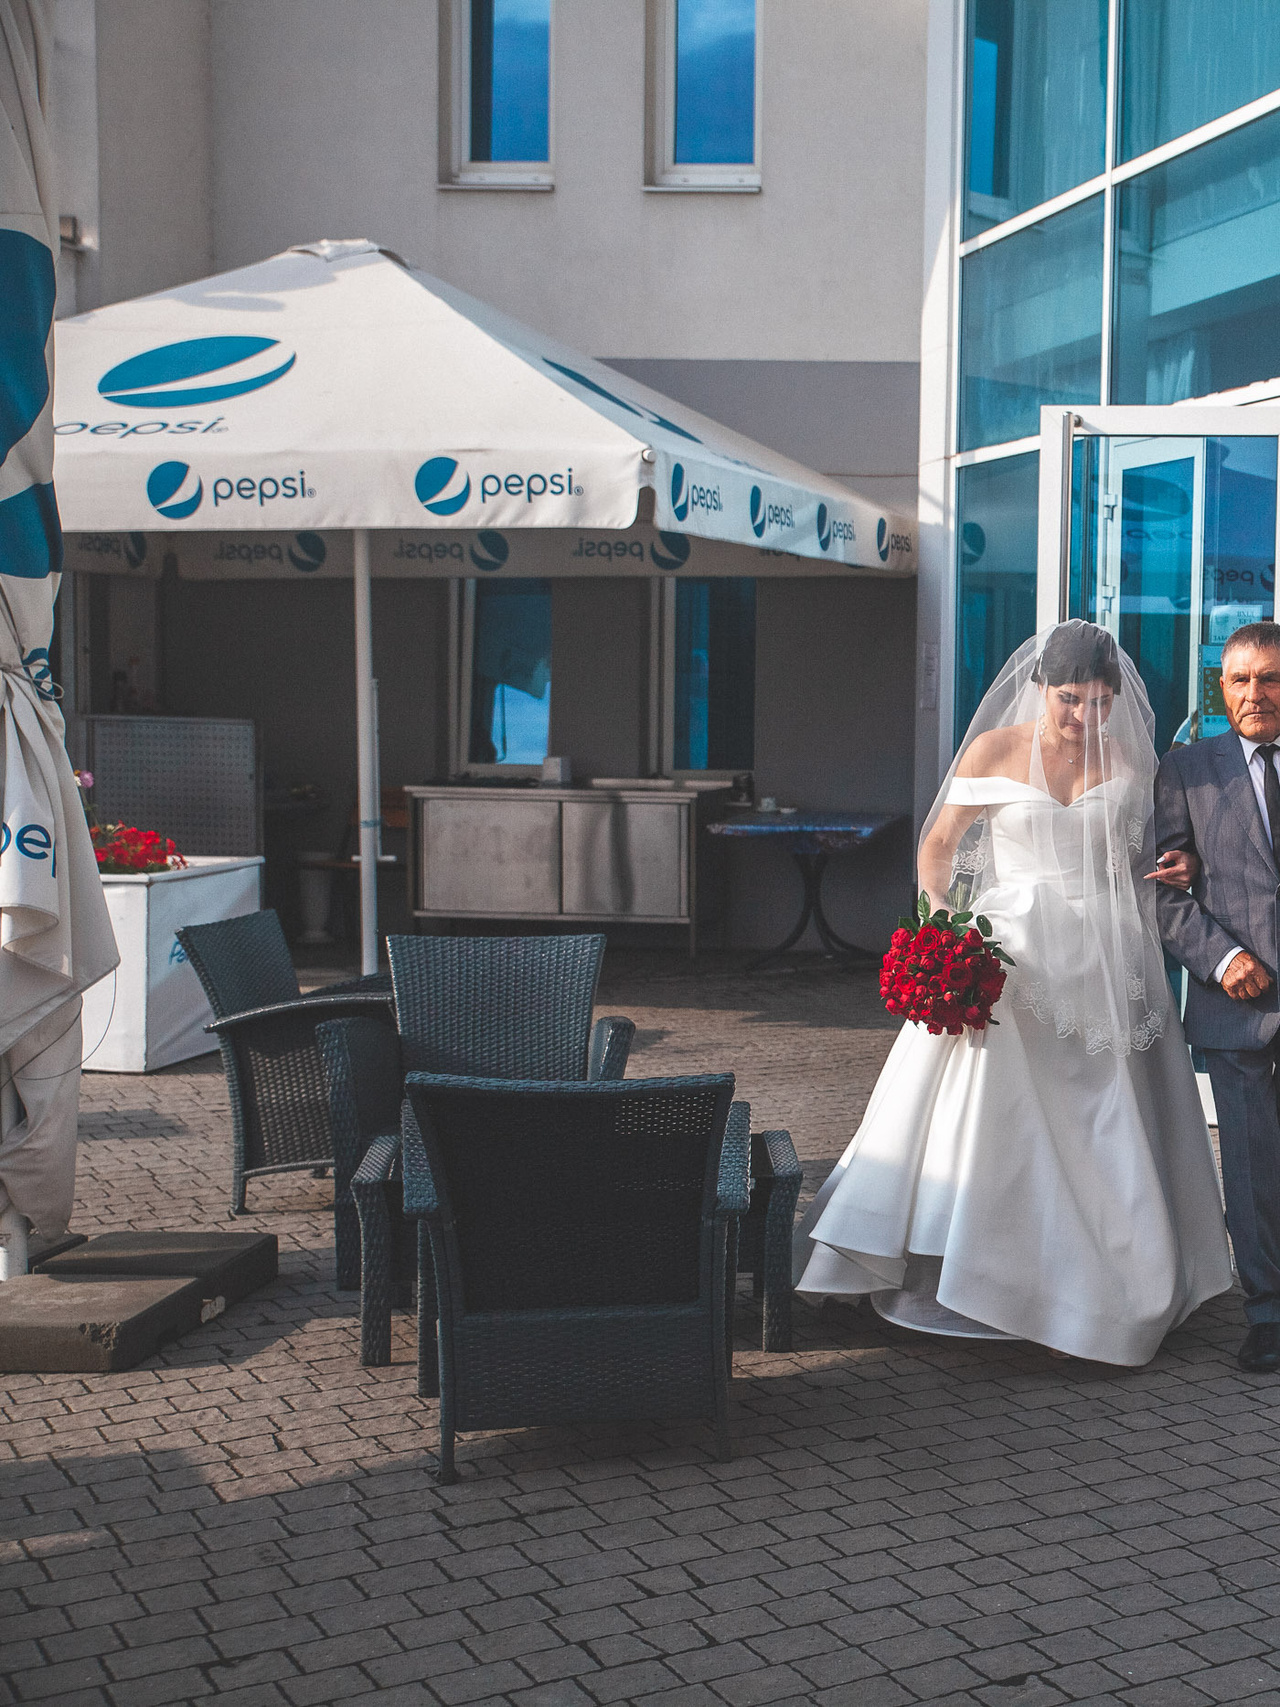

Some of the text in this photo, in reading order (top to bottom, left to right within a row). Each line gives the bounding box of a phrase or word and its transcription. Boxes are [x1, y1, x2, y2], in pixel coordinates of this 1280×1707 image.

[213, 469, 306, 507] pepsi
[481, 467, 573, 504] pepsi
[691, 484, 721, 515] pepsi
[767, 504, 794, 531] pepsi
